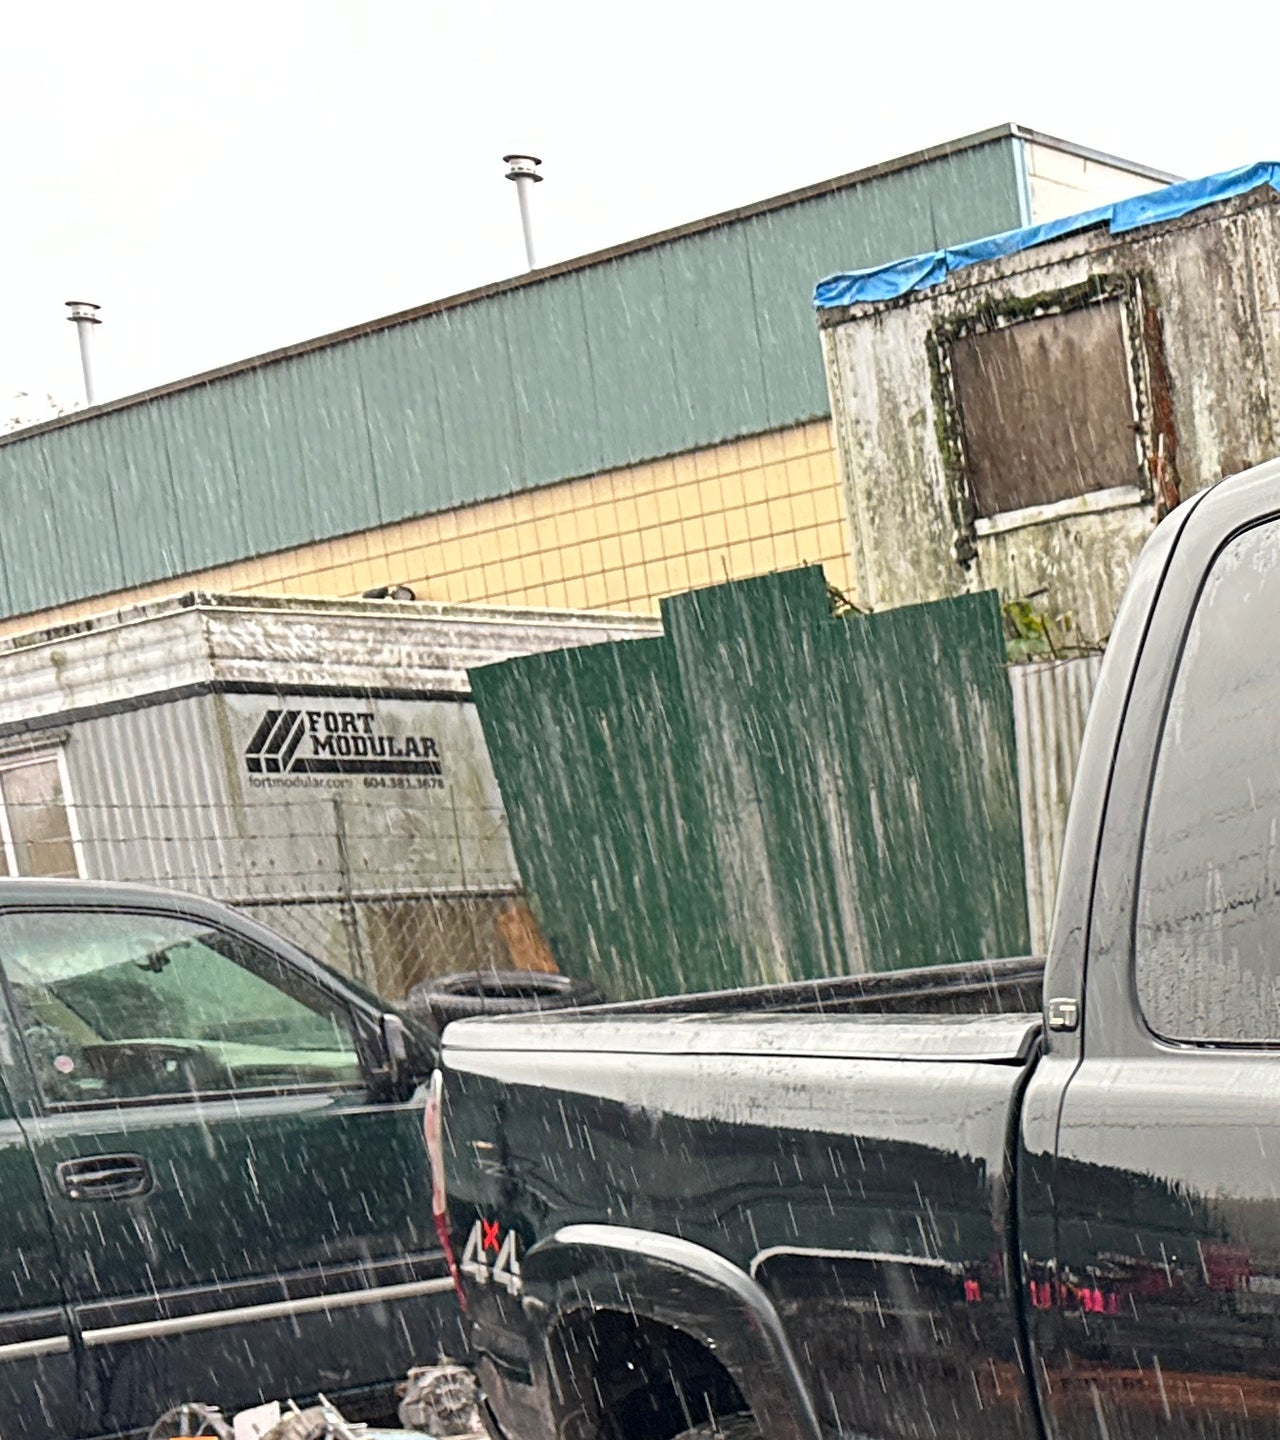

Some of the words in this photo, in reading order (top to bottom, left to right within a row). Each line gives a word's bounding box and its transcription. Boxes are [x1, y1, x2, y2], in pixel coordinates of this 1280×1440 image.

[305, 711, 375, 734] FORT
[309, 733, 440, 758] MODULAR
[248, 776, 354, 789] fortmodular.com
